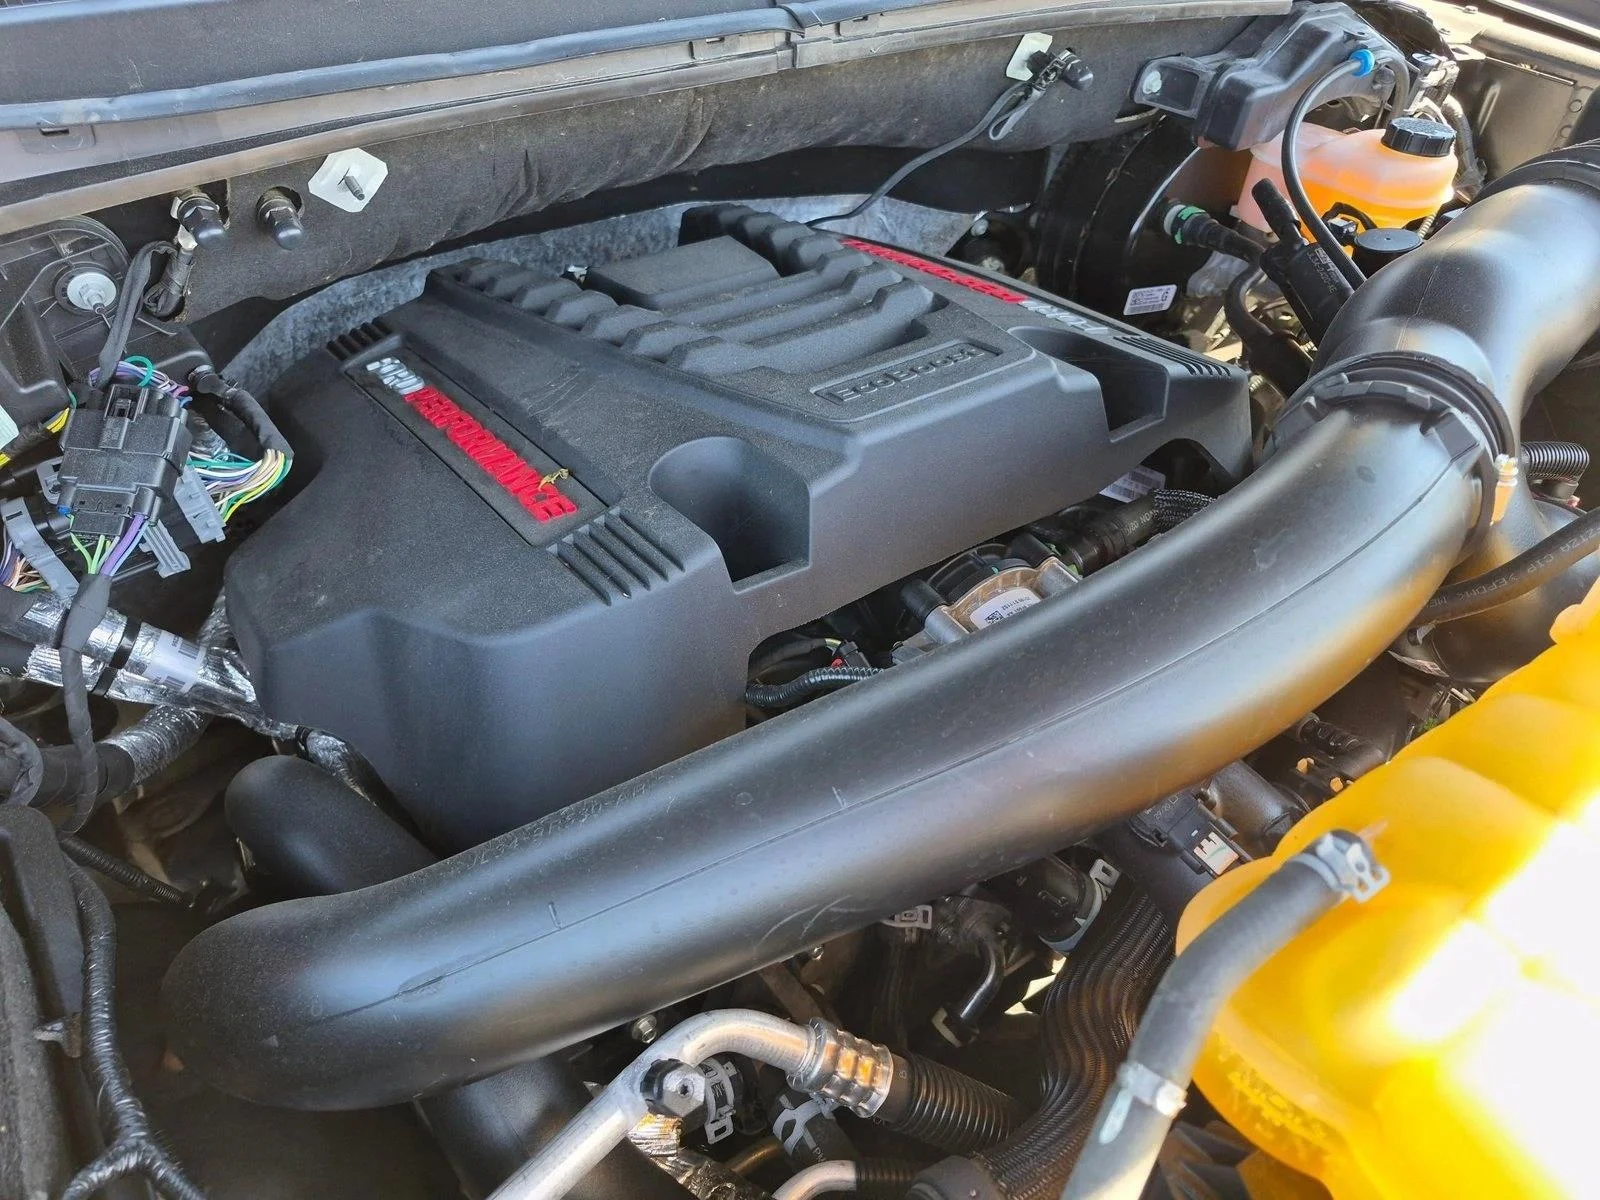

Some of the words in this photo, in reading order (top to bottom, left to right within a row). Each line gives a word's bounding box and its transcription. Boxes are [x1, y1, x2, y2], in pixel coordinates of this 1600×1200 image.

[833, 347, 986, 402] EcoBoost
[366, 357, 425, 395] FORD
[404, 385, 578, 523] PERFORMANCE
